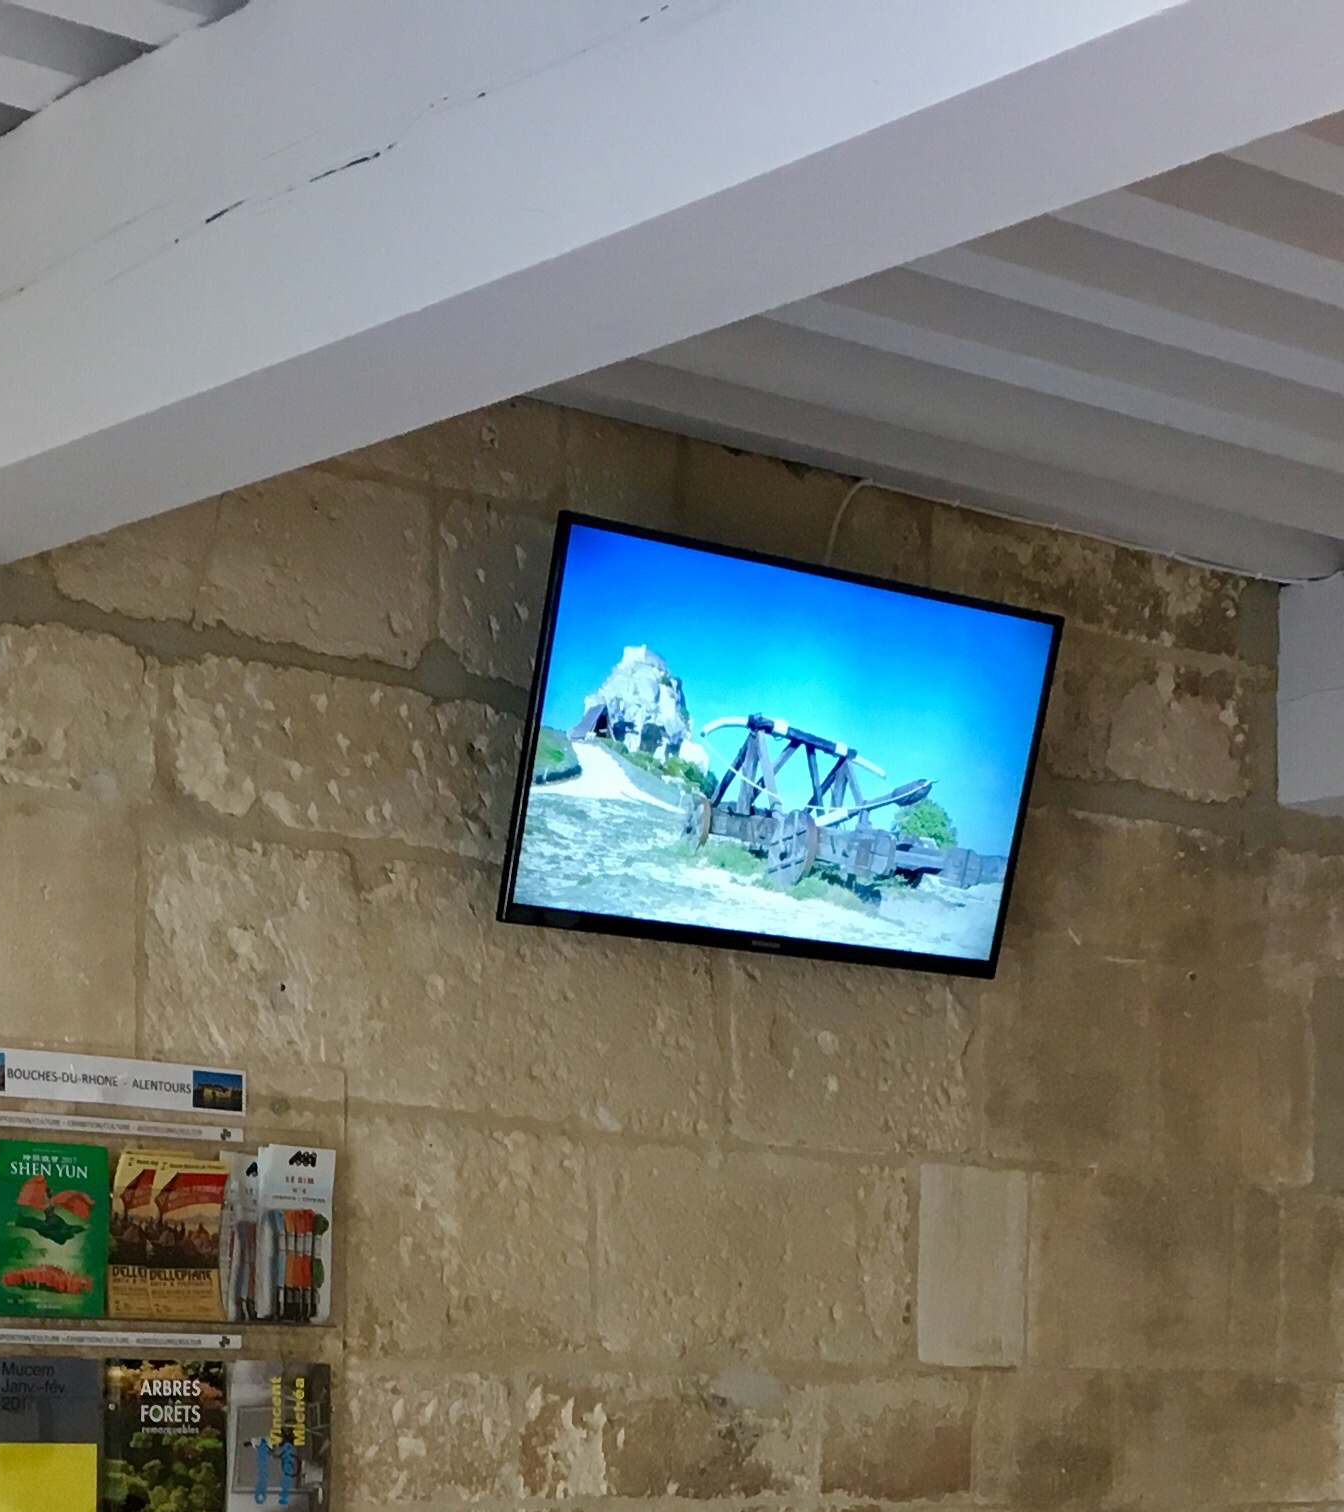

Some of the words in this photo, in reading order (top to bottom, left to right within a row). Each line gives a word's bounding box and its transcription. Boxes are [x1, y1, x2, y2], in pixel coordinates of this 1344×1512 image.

[132, 1078, 192, 1094] ALENTOURS
[10, 1162, 51, 1177] SHEN
[56, 1164, 88, 1179] YUN
[1, 1361, 55, 1377] Mucem
[140, 1379, 201, 1397] ARBRES
[140, 1401, 201, 1423] FORÊTS
[270, 1376, 283, 1445] Vincent
[294, 1377, 306, 1446] Michéa
